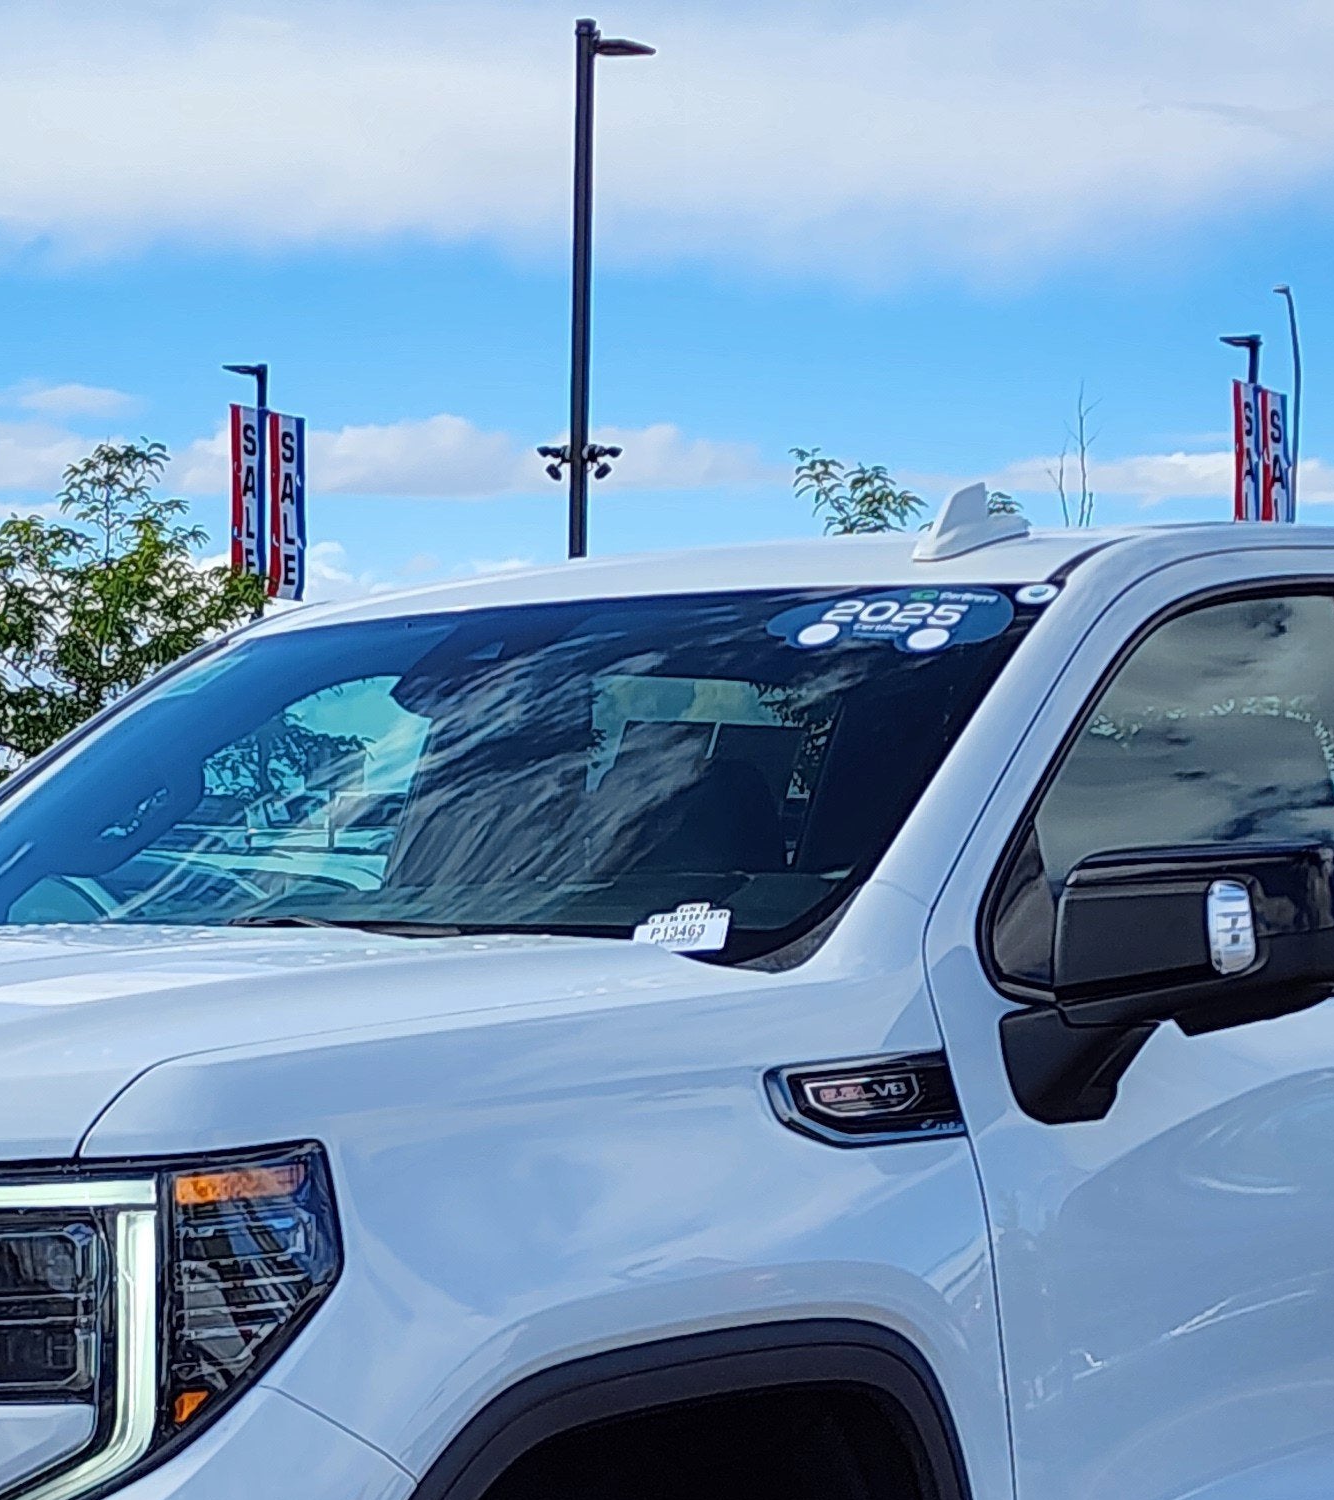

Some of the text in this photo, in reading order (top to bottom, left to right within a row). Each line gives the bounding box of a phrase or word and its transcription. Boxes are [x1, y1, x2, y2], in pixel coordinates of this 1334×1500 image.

[281, 431, 296, 586] SALE
[1244, 401, 1255, 520] SA
[1270, 409, 1286, 522] SA
[822, 599, 969, 626] 2025
